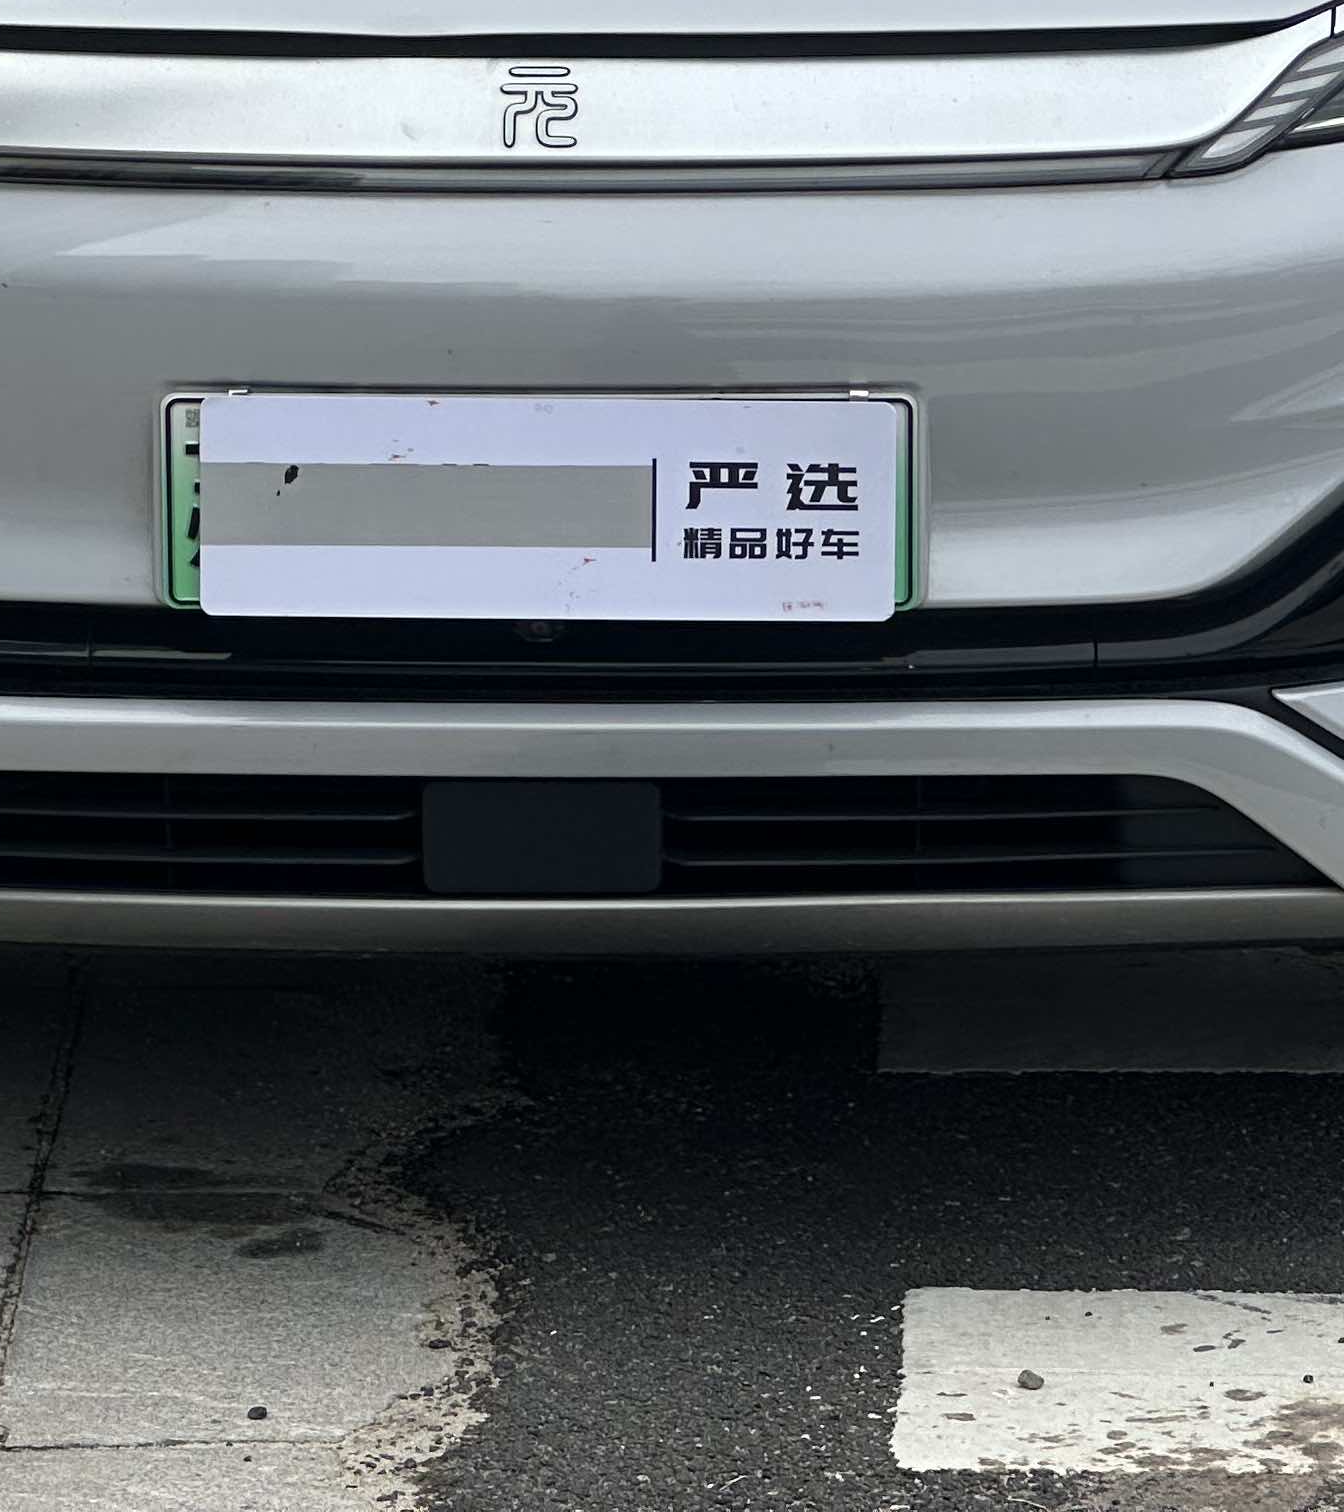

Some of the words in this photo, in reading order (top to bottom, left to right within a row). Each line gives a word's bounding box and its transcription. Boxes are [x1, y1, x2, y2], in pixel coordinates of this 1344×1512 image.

[500, 66, 578, 148] 元
[686, 461, 859, 511] 严选
[683, 527, 860, 560] 精品好车
